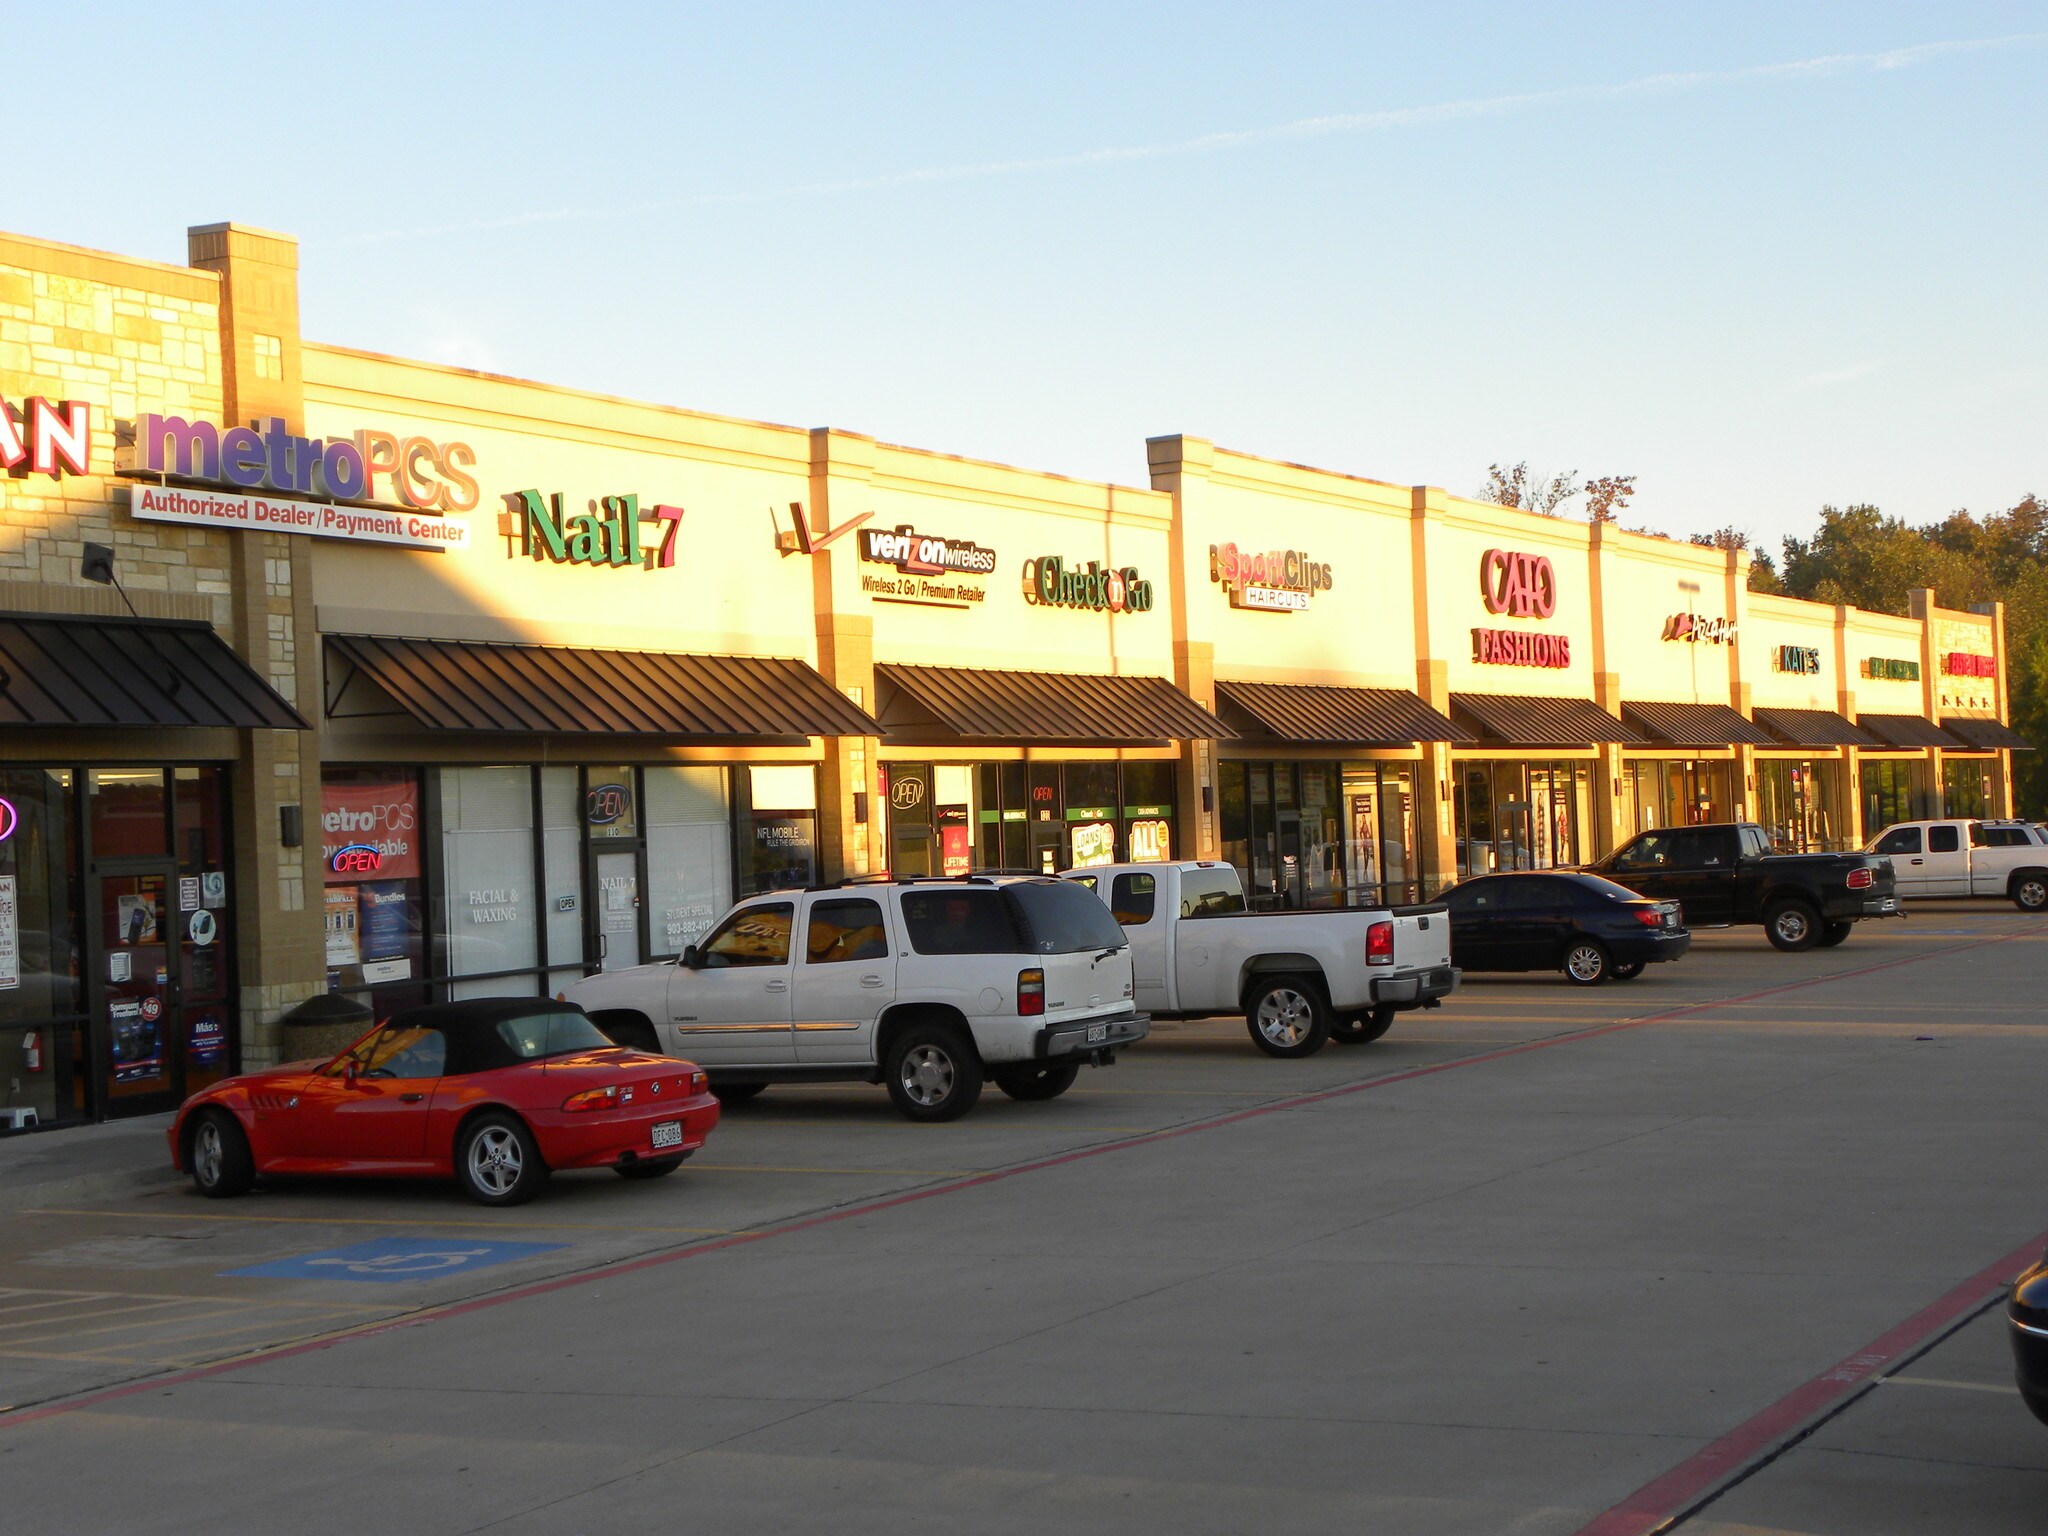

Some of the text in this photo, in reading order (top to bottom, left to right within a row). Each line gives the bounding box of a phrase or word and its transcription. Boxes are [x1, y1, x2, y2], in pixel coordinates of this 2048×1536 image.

[138, 413, 480, 511] metroPCS
[140, 489, 249, 520] Authorized
[407, 517, 465, 541] Center
[520, 489, 684, 568] Nail 7
[861, 574, 896, 594] Wireless
[896, 580, 904, 595] 2
[904, 581, 916, 596] Go
[921, 581, 956, 601] Premium
[956, 586, 986, 603] Retailer
[1038, 555, 1110, 608] Check
[1124, 565, 1154, 612] Go
[1480, 548, 1557, 619] CATO
[1250, 589, 1307, 607] HAIRCUTS
[1477, 627, 1571, 668] FASHIONS
[892, 782, 922, 804] OPEN
[1033, 787, 1053, 800] OPEN
[588, 791, 626, 816] OPEN
[321, 803, 414, 832] etroPCS
[757, 827, 799, 839] NFL MOBILE
[1076, 830, 1099, 849] LOANS
[1132, 824, 1160, 858] ALL
[335, 853, 382, 872] OPEN
[944, 856, 969, 868] LIFETIME
[600, 877, 627, 890] NAIL
[375, 892, 406, 903] Bundles
[469, 888, 519, 905] FACIAL &
[559, 898, 576, 909] OPEN
[473, 906, 518, 924] WAXING
